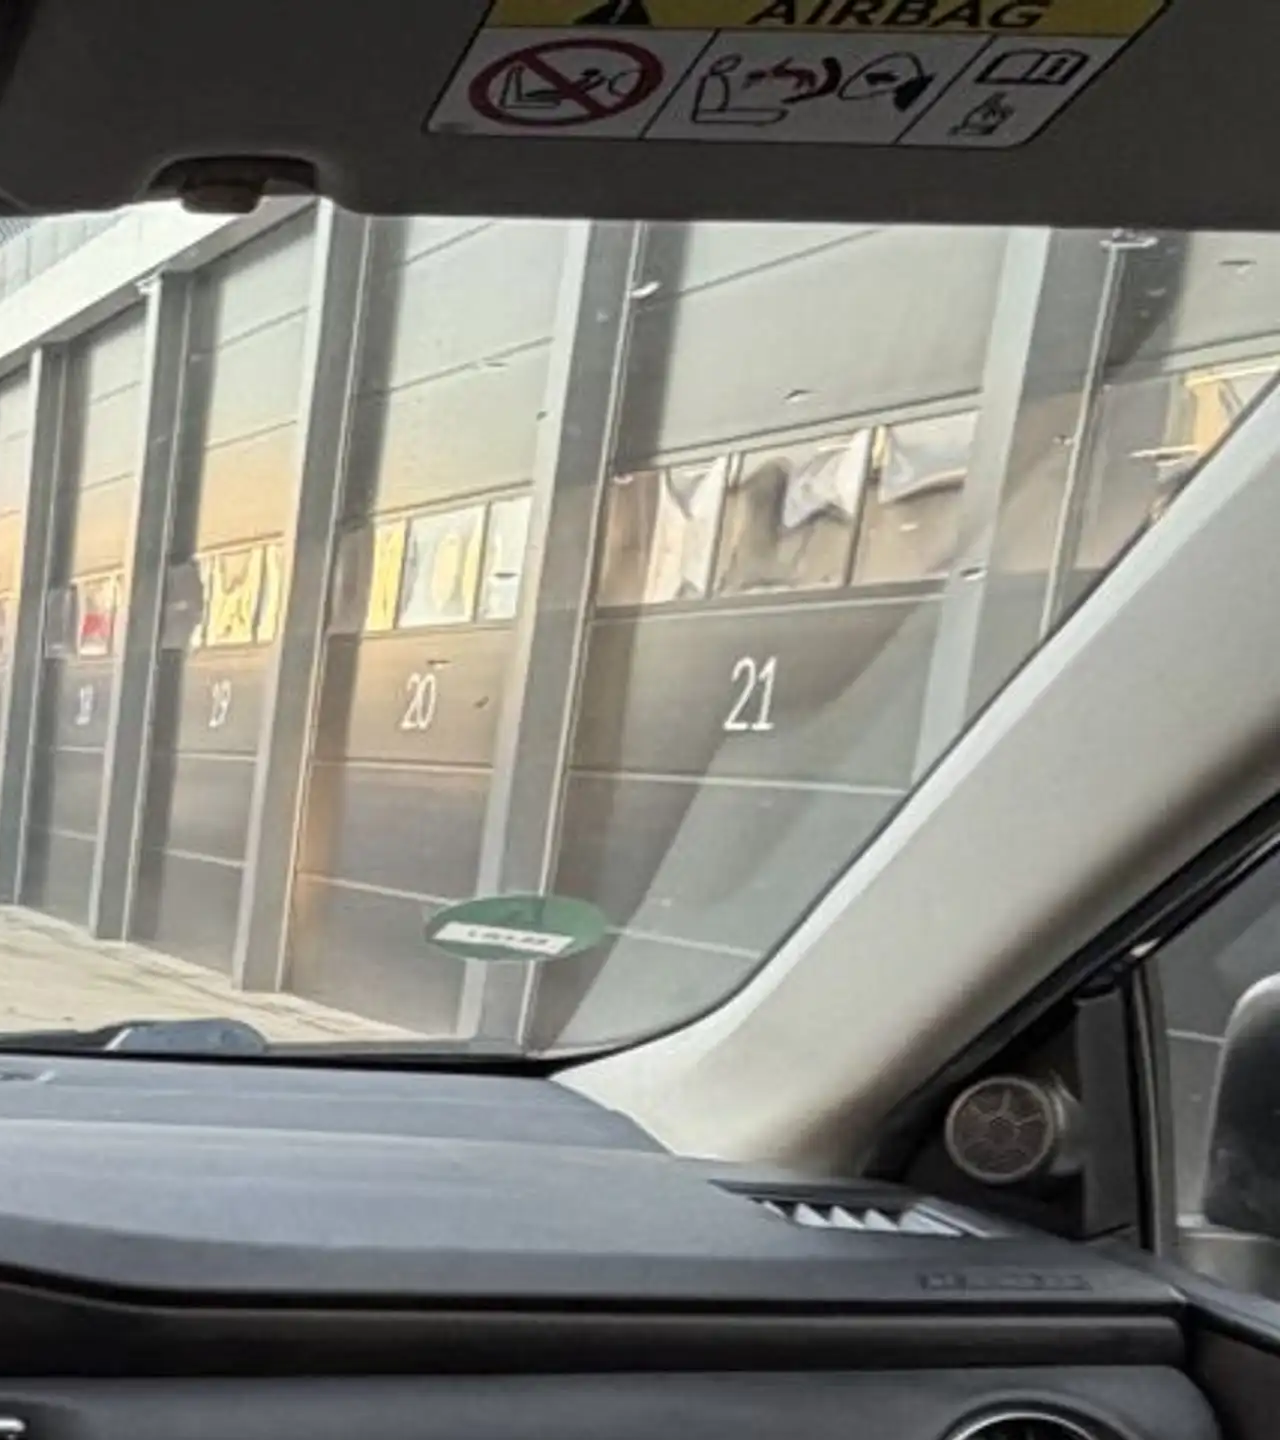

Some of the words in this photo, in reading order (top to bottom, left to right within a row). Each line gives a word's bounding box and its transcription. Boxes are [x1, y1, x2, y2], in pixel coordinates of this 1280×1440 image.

[744, 0, 1049, 28] AIRBAG
[400, 672, 436, 730] 20
[723, 656, 777, 730] 21
